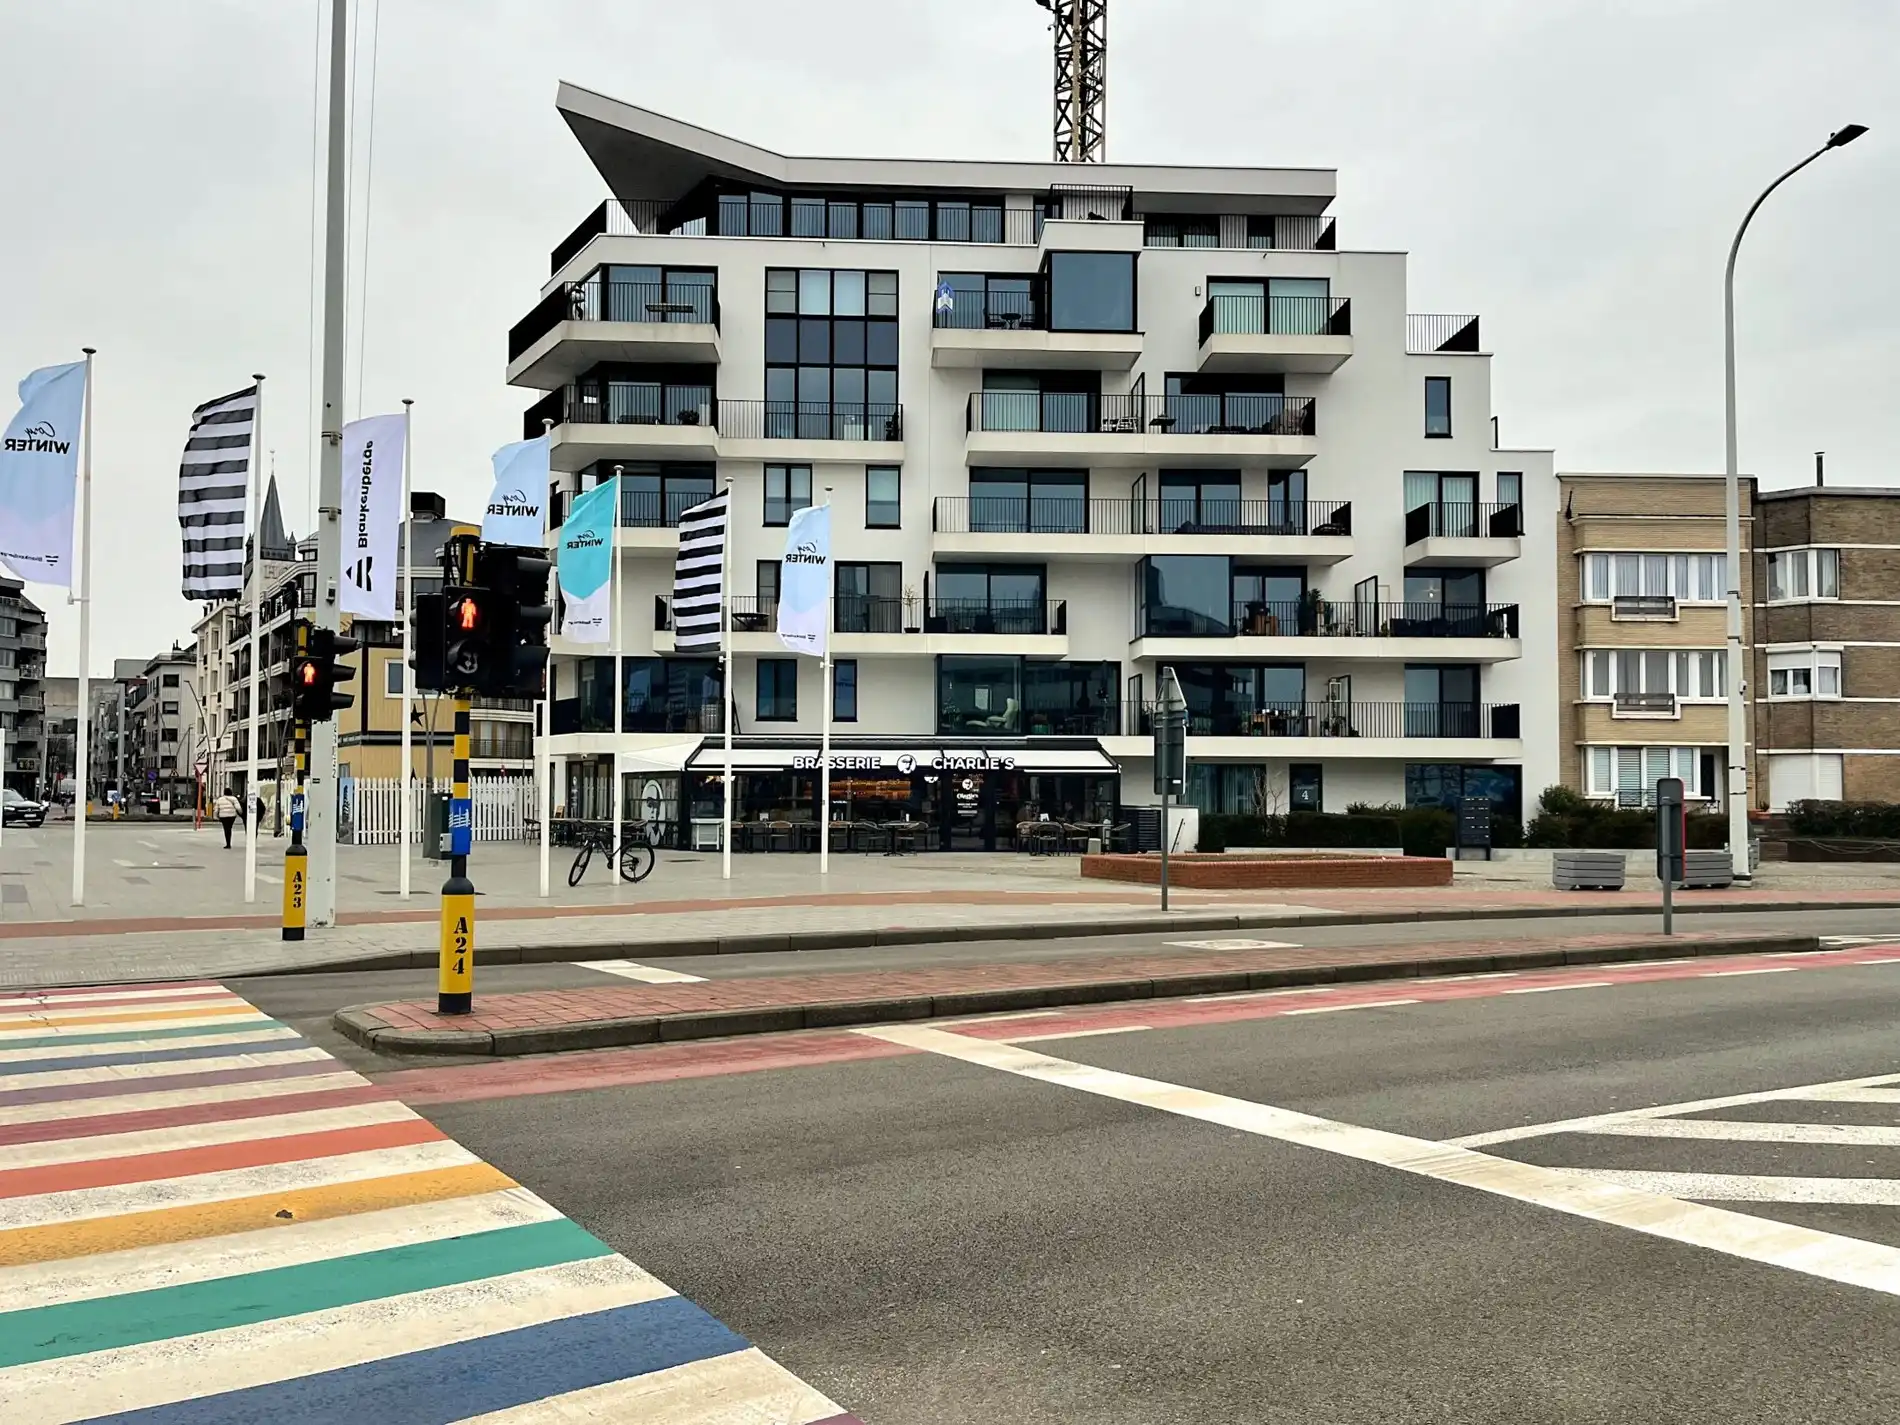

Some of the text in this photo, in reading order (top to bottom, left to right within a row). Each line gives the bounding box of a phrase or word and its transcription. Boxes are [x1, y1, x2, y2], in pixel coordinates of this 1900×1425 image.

[793, 756, 1015, 771] BRASSERIE CHARLIE'S
[1301, 790, 1309, 800] 4
[292, 871, 303, 908] A23
[452, 916, 469, 975] A24
